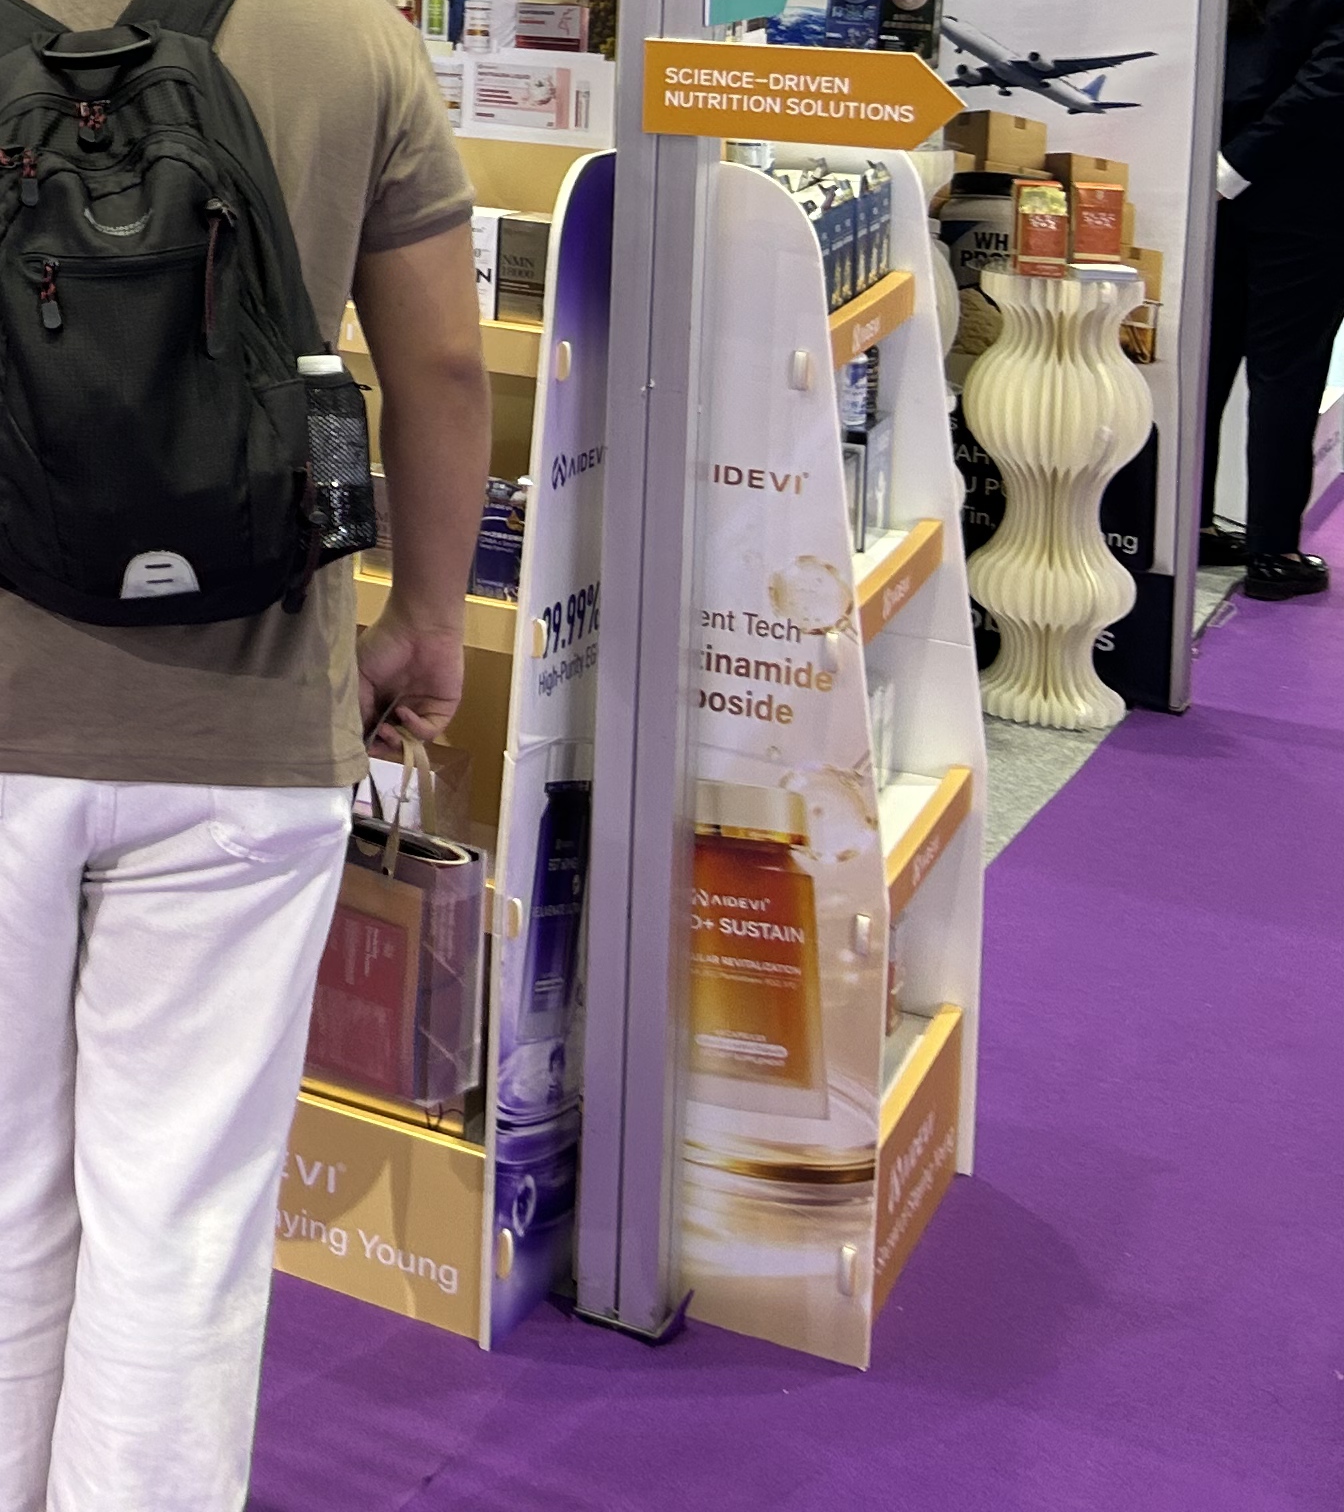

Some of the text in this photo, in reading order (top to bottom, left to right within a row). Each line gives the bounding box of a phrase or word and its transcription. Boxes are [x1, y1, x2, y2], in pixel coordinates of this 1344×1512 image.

[664, 90, 914, 124] NUTRITION SOLUTIONS
[973, 232, 1009, 252] WH
[742, 610, 802, 644] Tech
[700, 643, 834, 693] inamide
[710, 894, 766, 912] AIDEVI
[718, 917, 806, 945] SUSTAIN
[358, 1228, 459, 1296] Young
